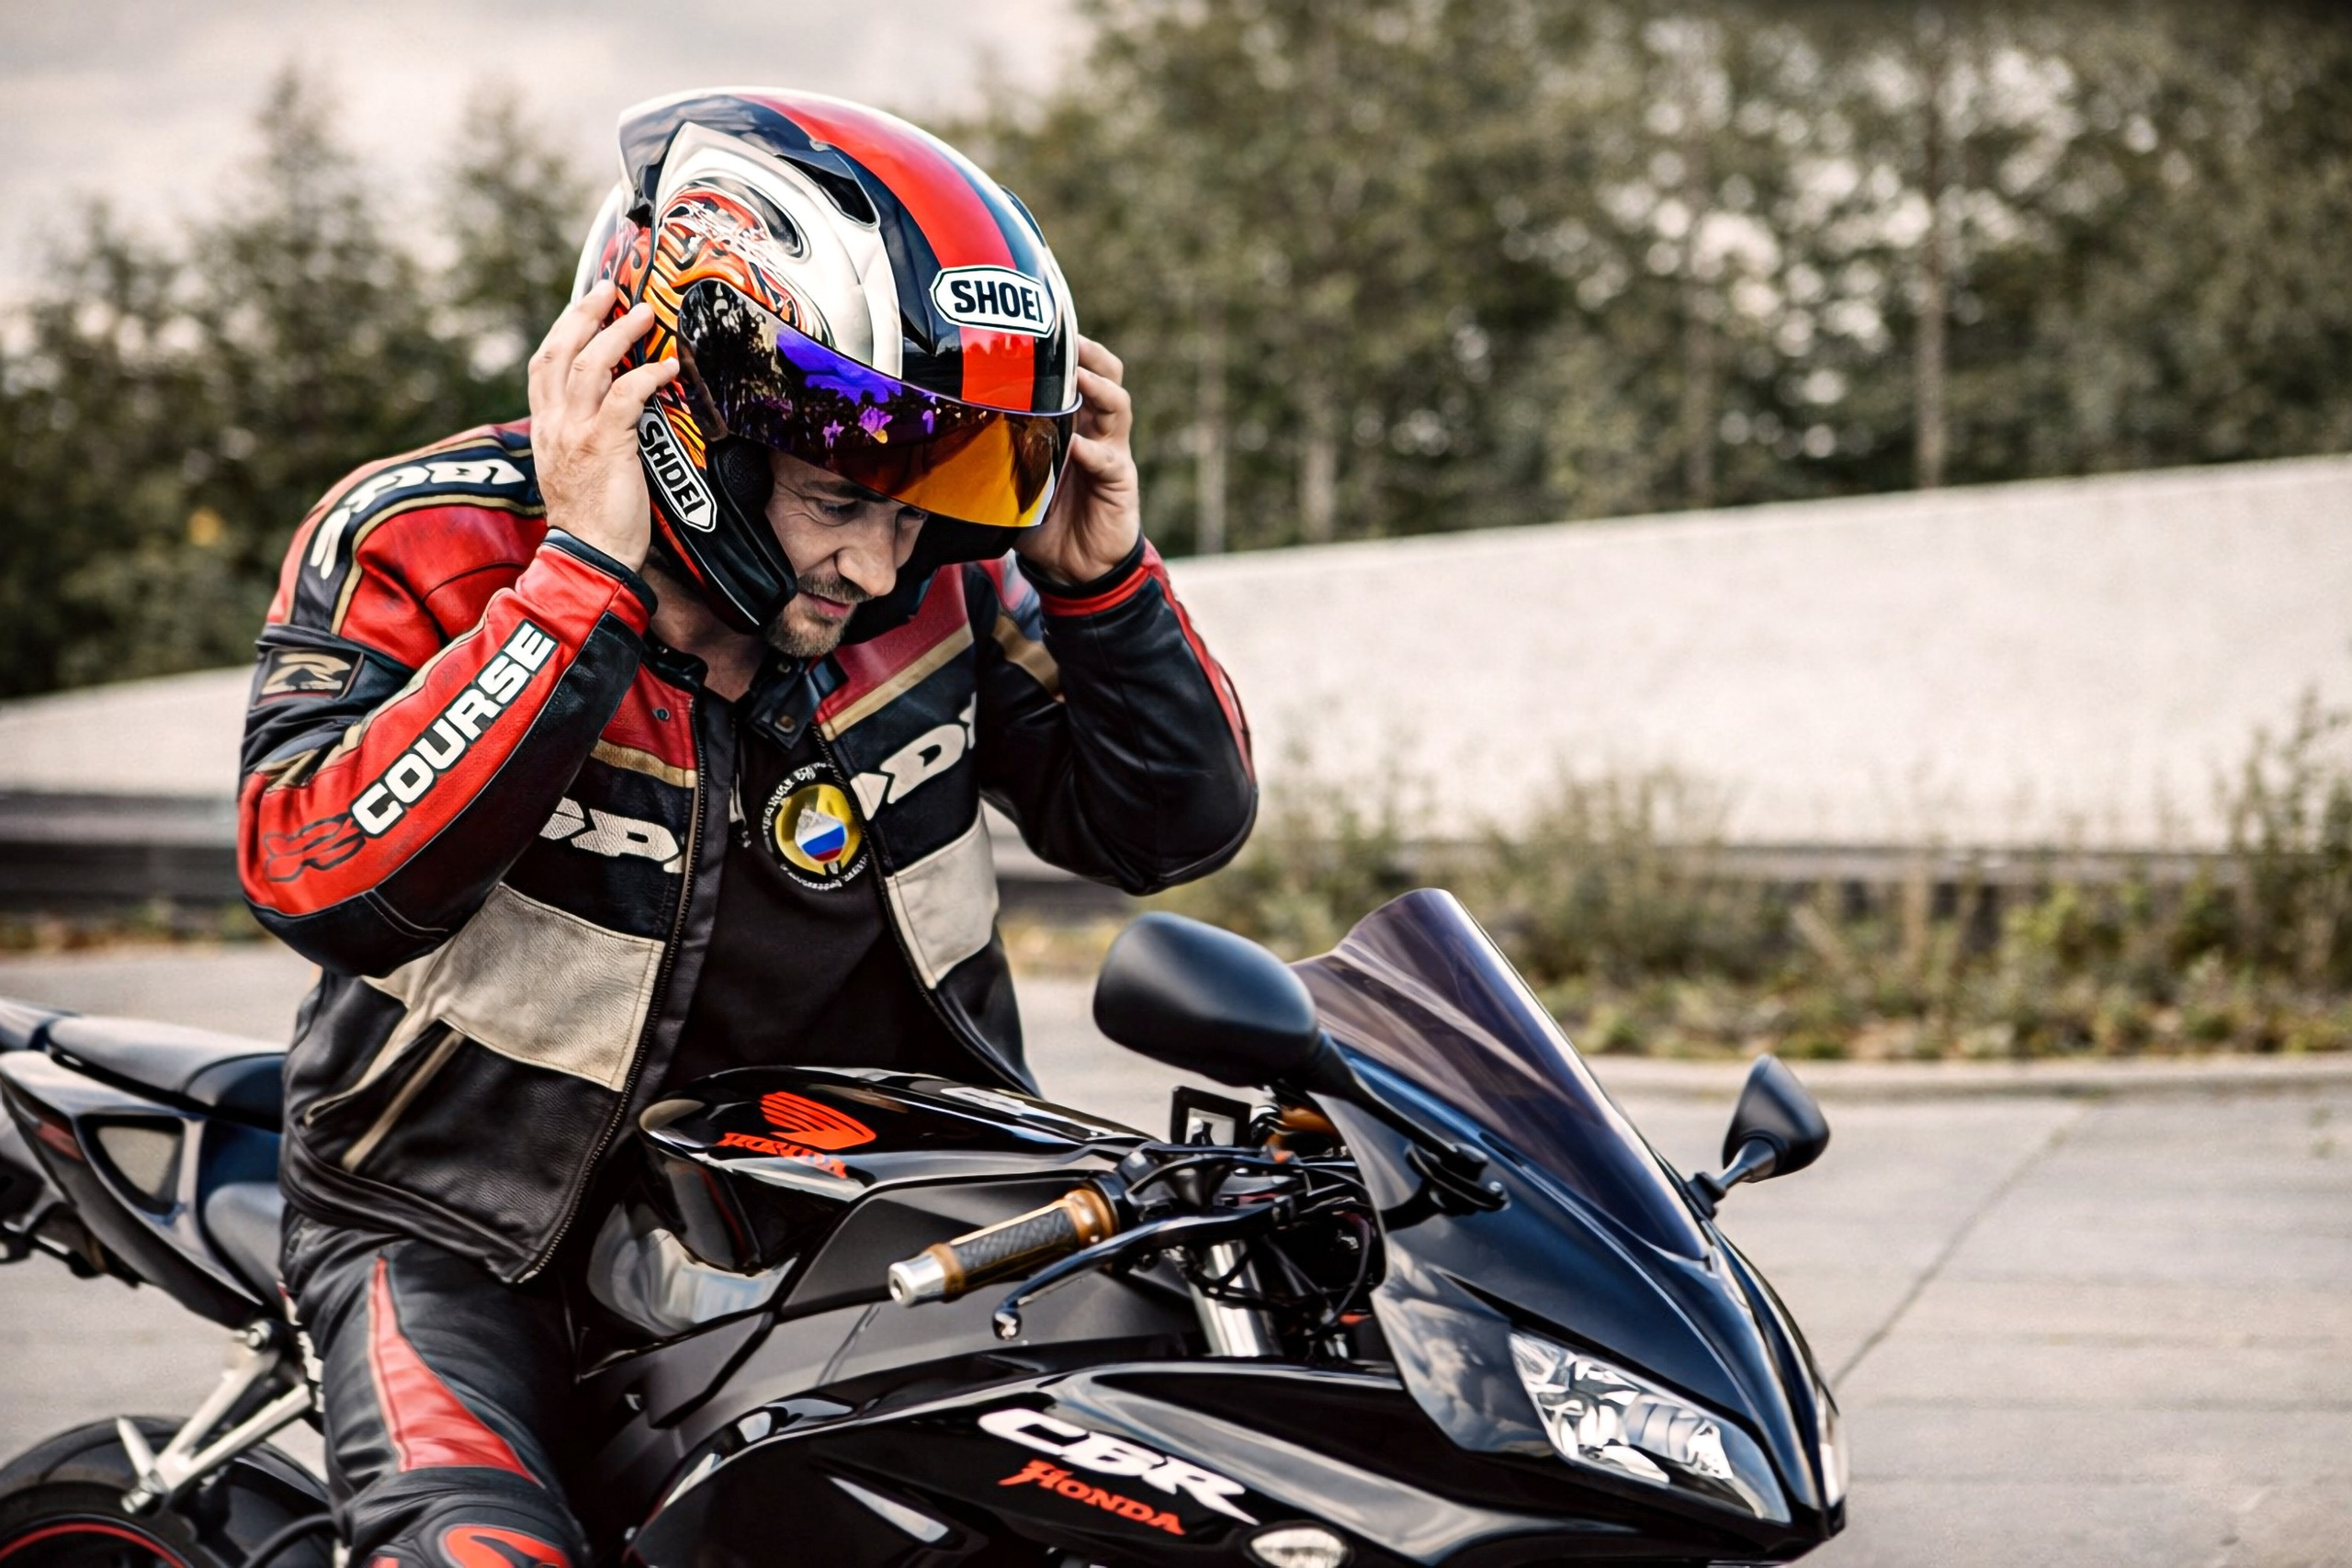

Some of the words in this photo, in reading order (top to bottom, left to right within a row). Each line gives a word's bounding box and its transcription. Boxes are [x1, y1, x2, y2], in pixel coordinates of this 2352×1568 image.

[950, 279, 1044, 324] SHOEI
[638, 420, 707, 518] SHOEI
[351, 621, 557, 836] COURSE
[978, 1407, 1261, 1526] CBR
[997, 1459, 1186, 1536] HONDA
